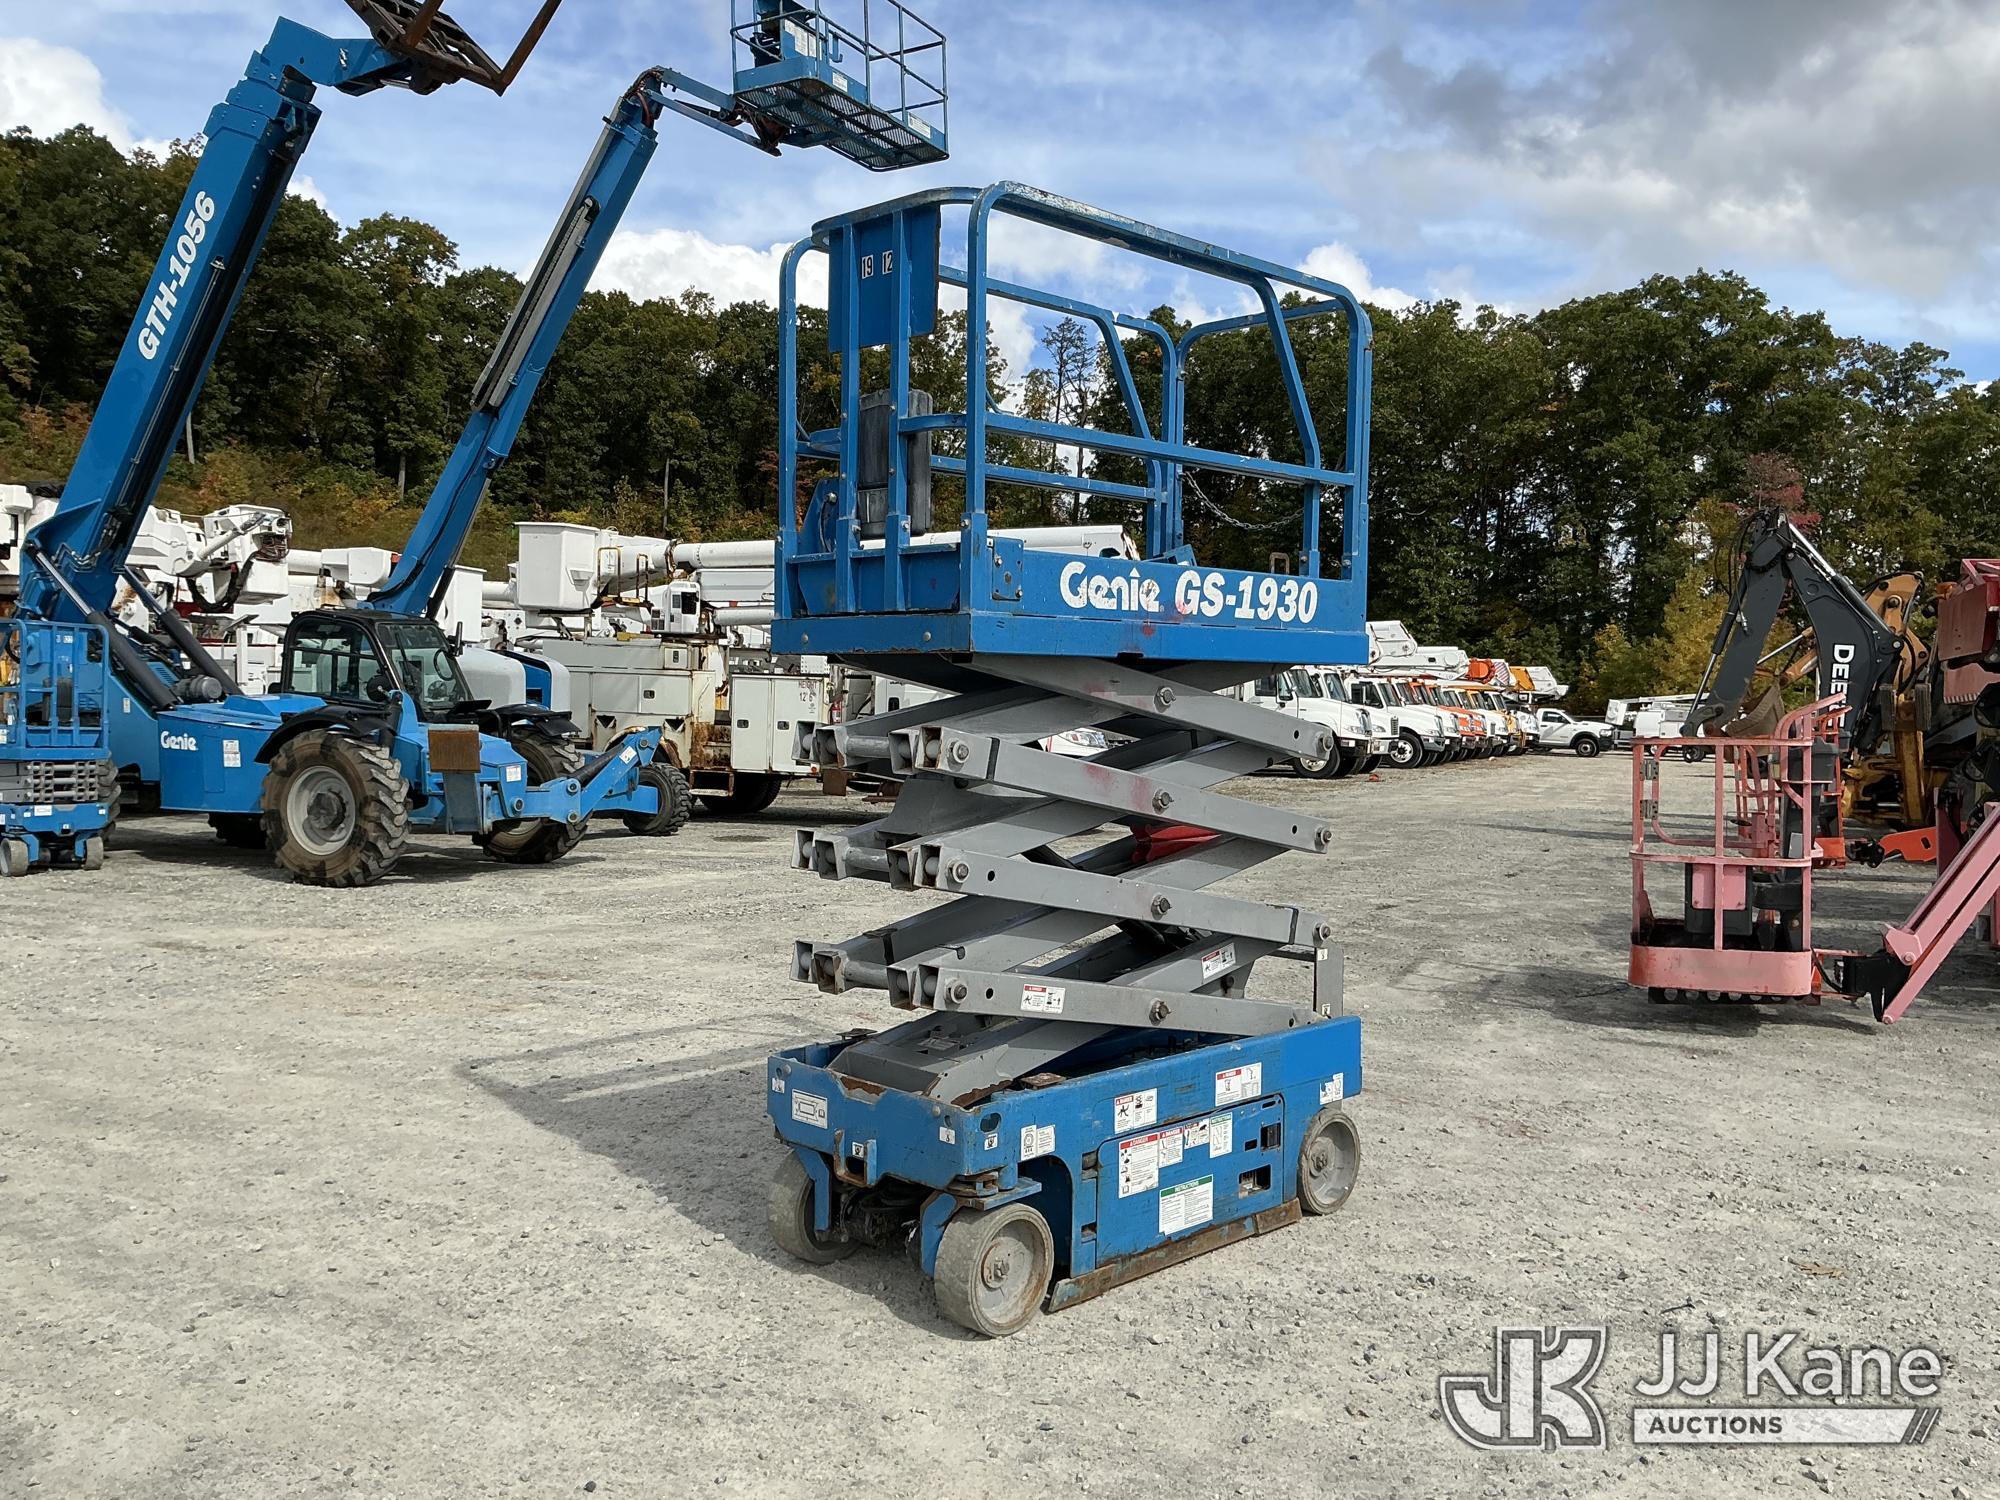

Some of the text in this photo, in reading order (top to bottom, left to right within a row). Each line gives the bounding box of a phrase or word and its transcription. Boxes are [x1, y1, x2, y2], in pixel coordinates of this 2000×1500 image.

[138, 190, 215, 359] GTH-1056
[1059, 561, 1319, 625] Genie GS-1930
[160, 730, 197, 751] Genie
